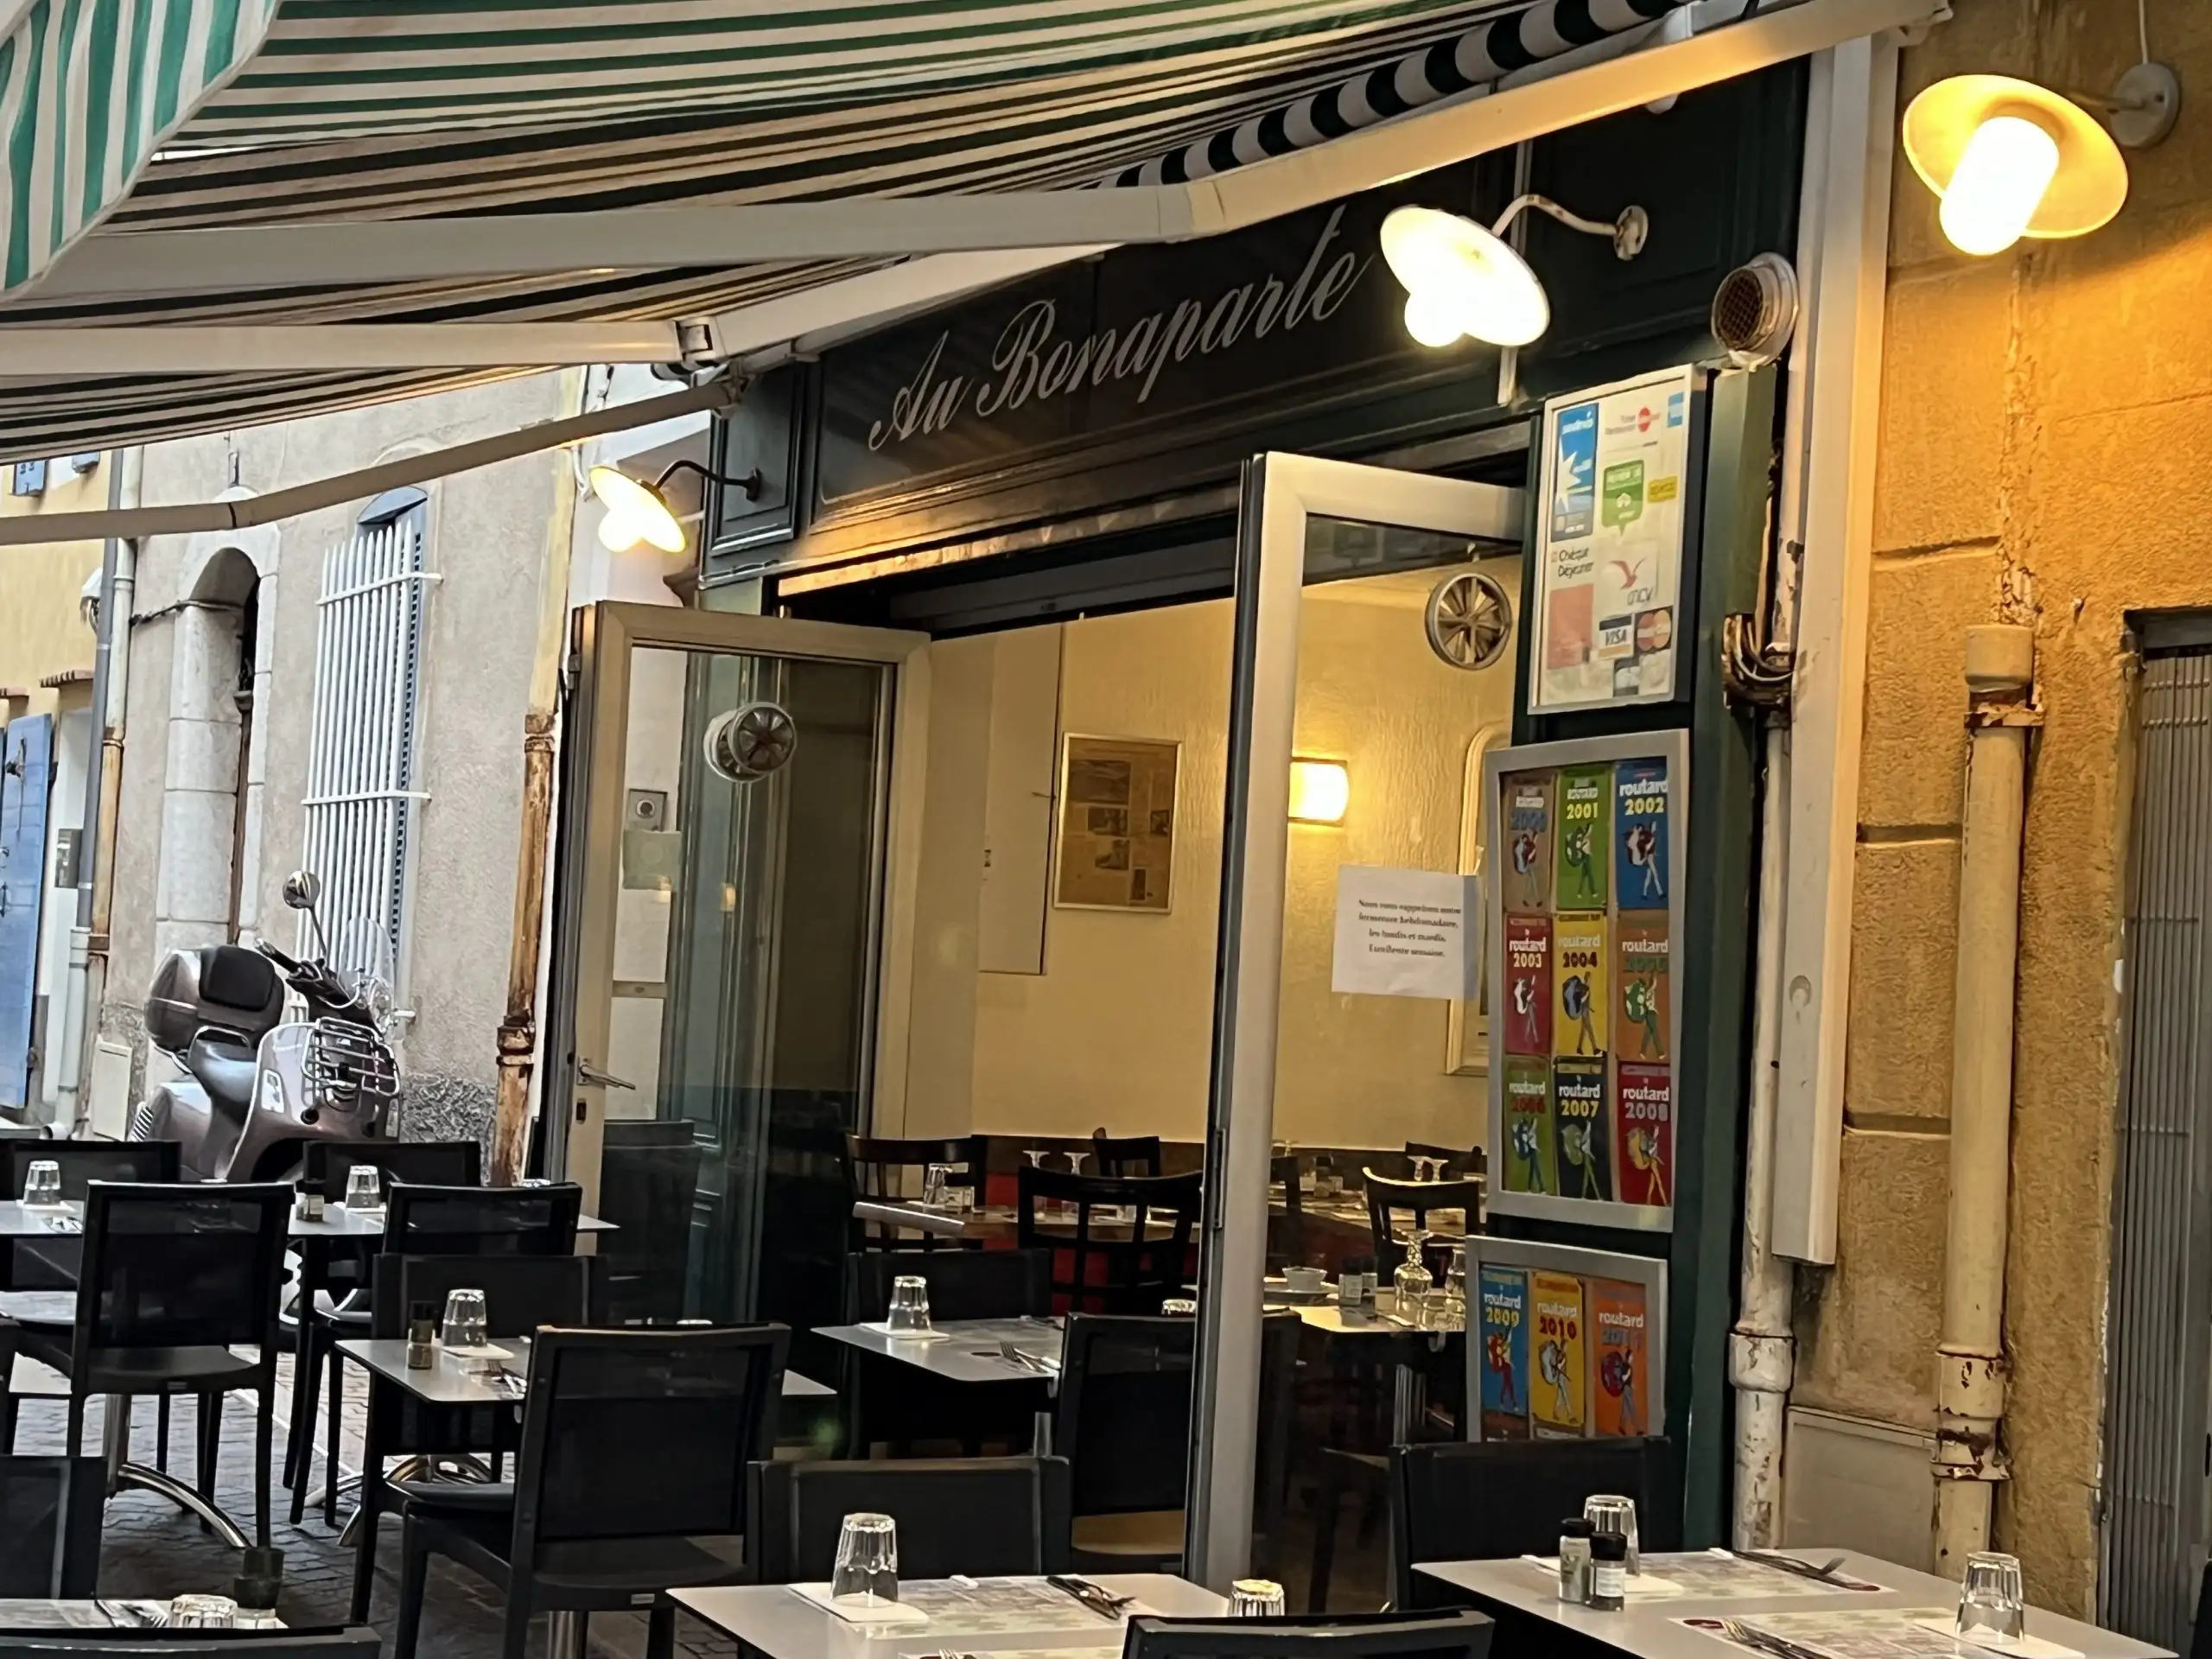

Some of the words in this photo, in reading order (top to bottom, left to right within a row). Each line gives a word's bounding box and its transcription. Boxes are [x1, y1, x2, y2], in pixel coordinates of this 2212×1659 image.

[868, 330, 974, 451] Au
[976, 204, 1375, 417] Bonaparte
[1605, 629, 1628, 645] VISA
[1567, 802, 1599, 819] 2001
[1624, 797, 1664, 816] 2002
[1509, 936, 1547, 951] routard
[1558, 934, 1600, 948] routard
[1622, 938, 1669, 953] routard
[1513, 952, 1542, 968] 2003
[1562, 952, 1598, 968] 2004
[1509, 1080, 1545, 1095] routard
[1559, 1084, 1600, 1098] routard
[1623, 1087, 1669, 1102] routard
[1560, 1099, 1599, 1116] 2007
[1484, 1293, 1522, 1308] routard
[1485, 1306, 1520, 1327] 2009
[1537, 1301, 1578, 1318] routard
[1539, 1315, 1577, 1340] 2010
[1599, 1311, 1644, 1328] routard
